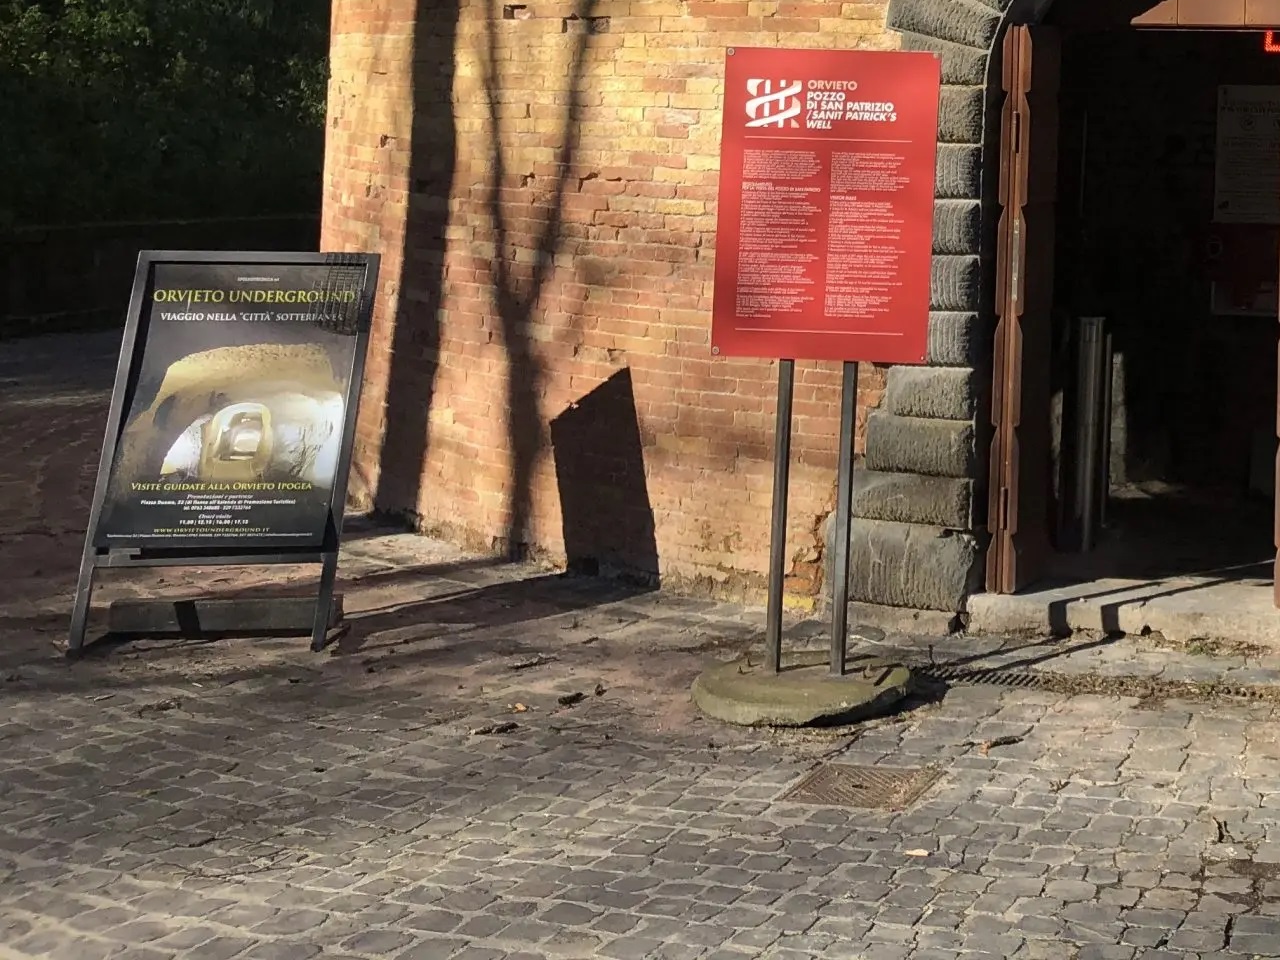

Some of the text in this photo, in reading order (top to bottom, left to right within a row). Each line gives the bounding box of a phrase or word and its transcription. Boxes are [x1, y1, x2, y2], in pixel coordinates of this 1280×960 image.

[807, 79, 858, 91] ORVIETO
[806, 91, 846, 101] POZZO
[806, 101, 895, 112] DI SAN PATRIZIO
[845, 112, 897, 122] PATRICK'S
[806, 120, 832, 130] WELL
[153, 289, 356, 309] ORVIETO UNDERGROUND
[160, 312, 204, 321] VIAGGIO
[206, 312, 237, 321] NELLA
[131, 482, 312, 491] VISITE GUIDATE ALLA ORVIETO IPOGEA
